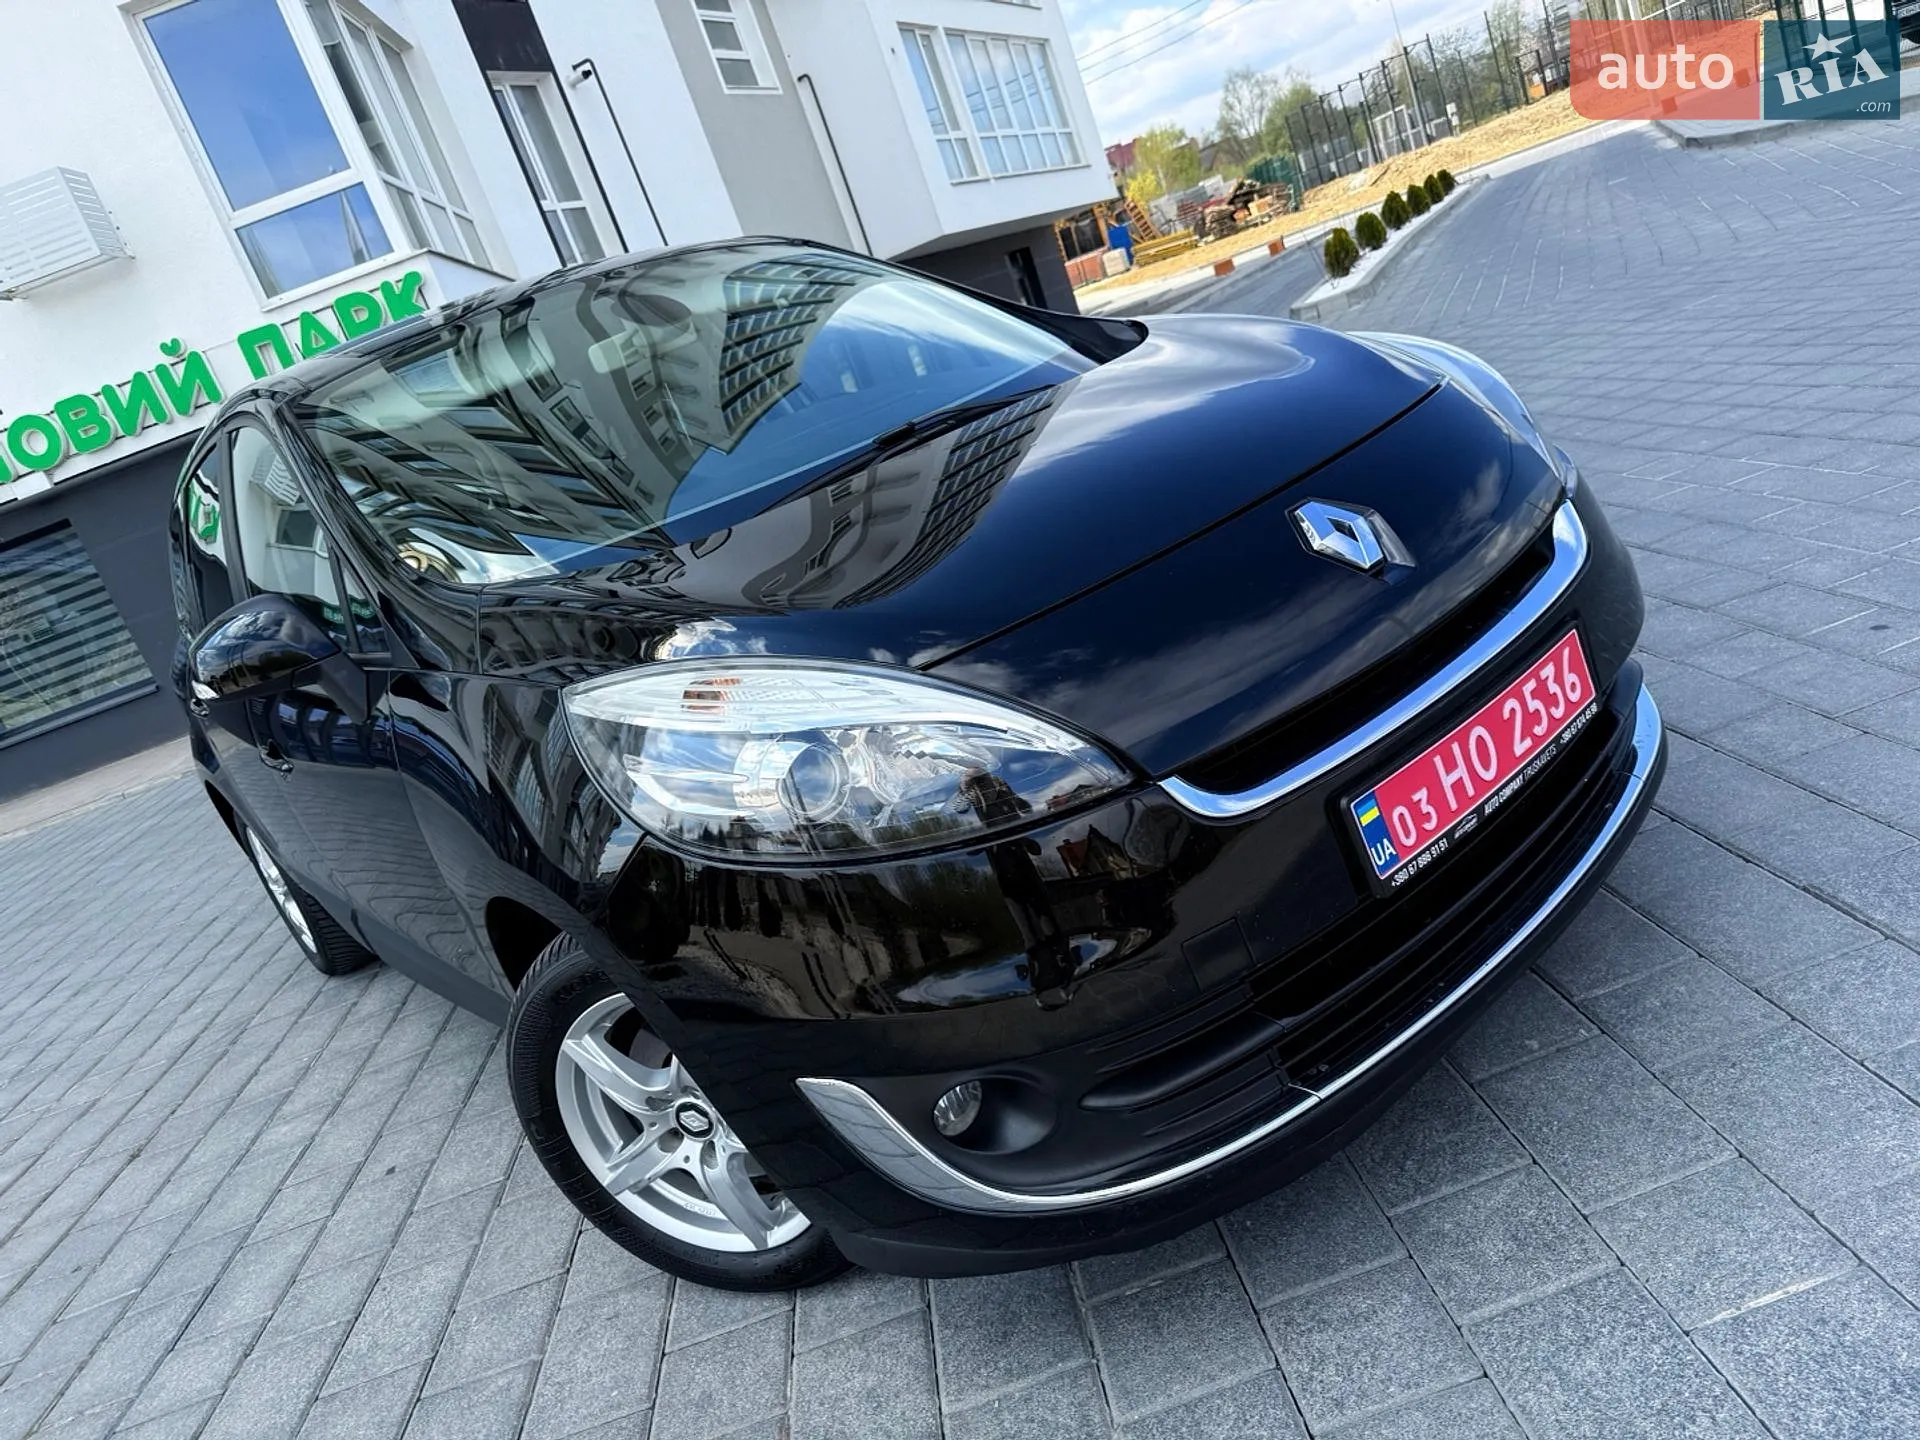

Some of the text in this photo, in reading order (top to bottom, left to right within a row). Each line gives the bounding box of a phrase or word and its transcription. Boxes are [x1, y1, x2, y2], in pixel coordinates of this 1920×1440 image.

[0, 270, 424, 484] ОВИЙ ПАРК
[1391, 787, 1438, 848] 03
[1502, 646, 1582, 758] 2536
[1371, 837, 1397, 867] UA
